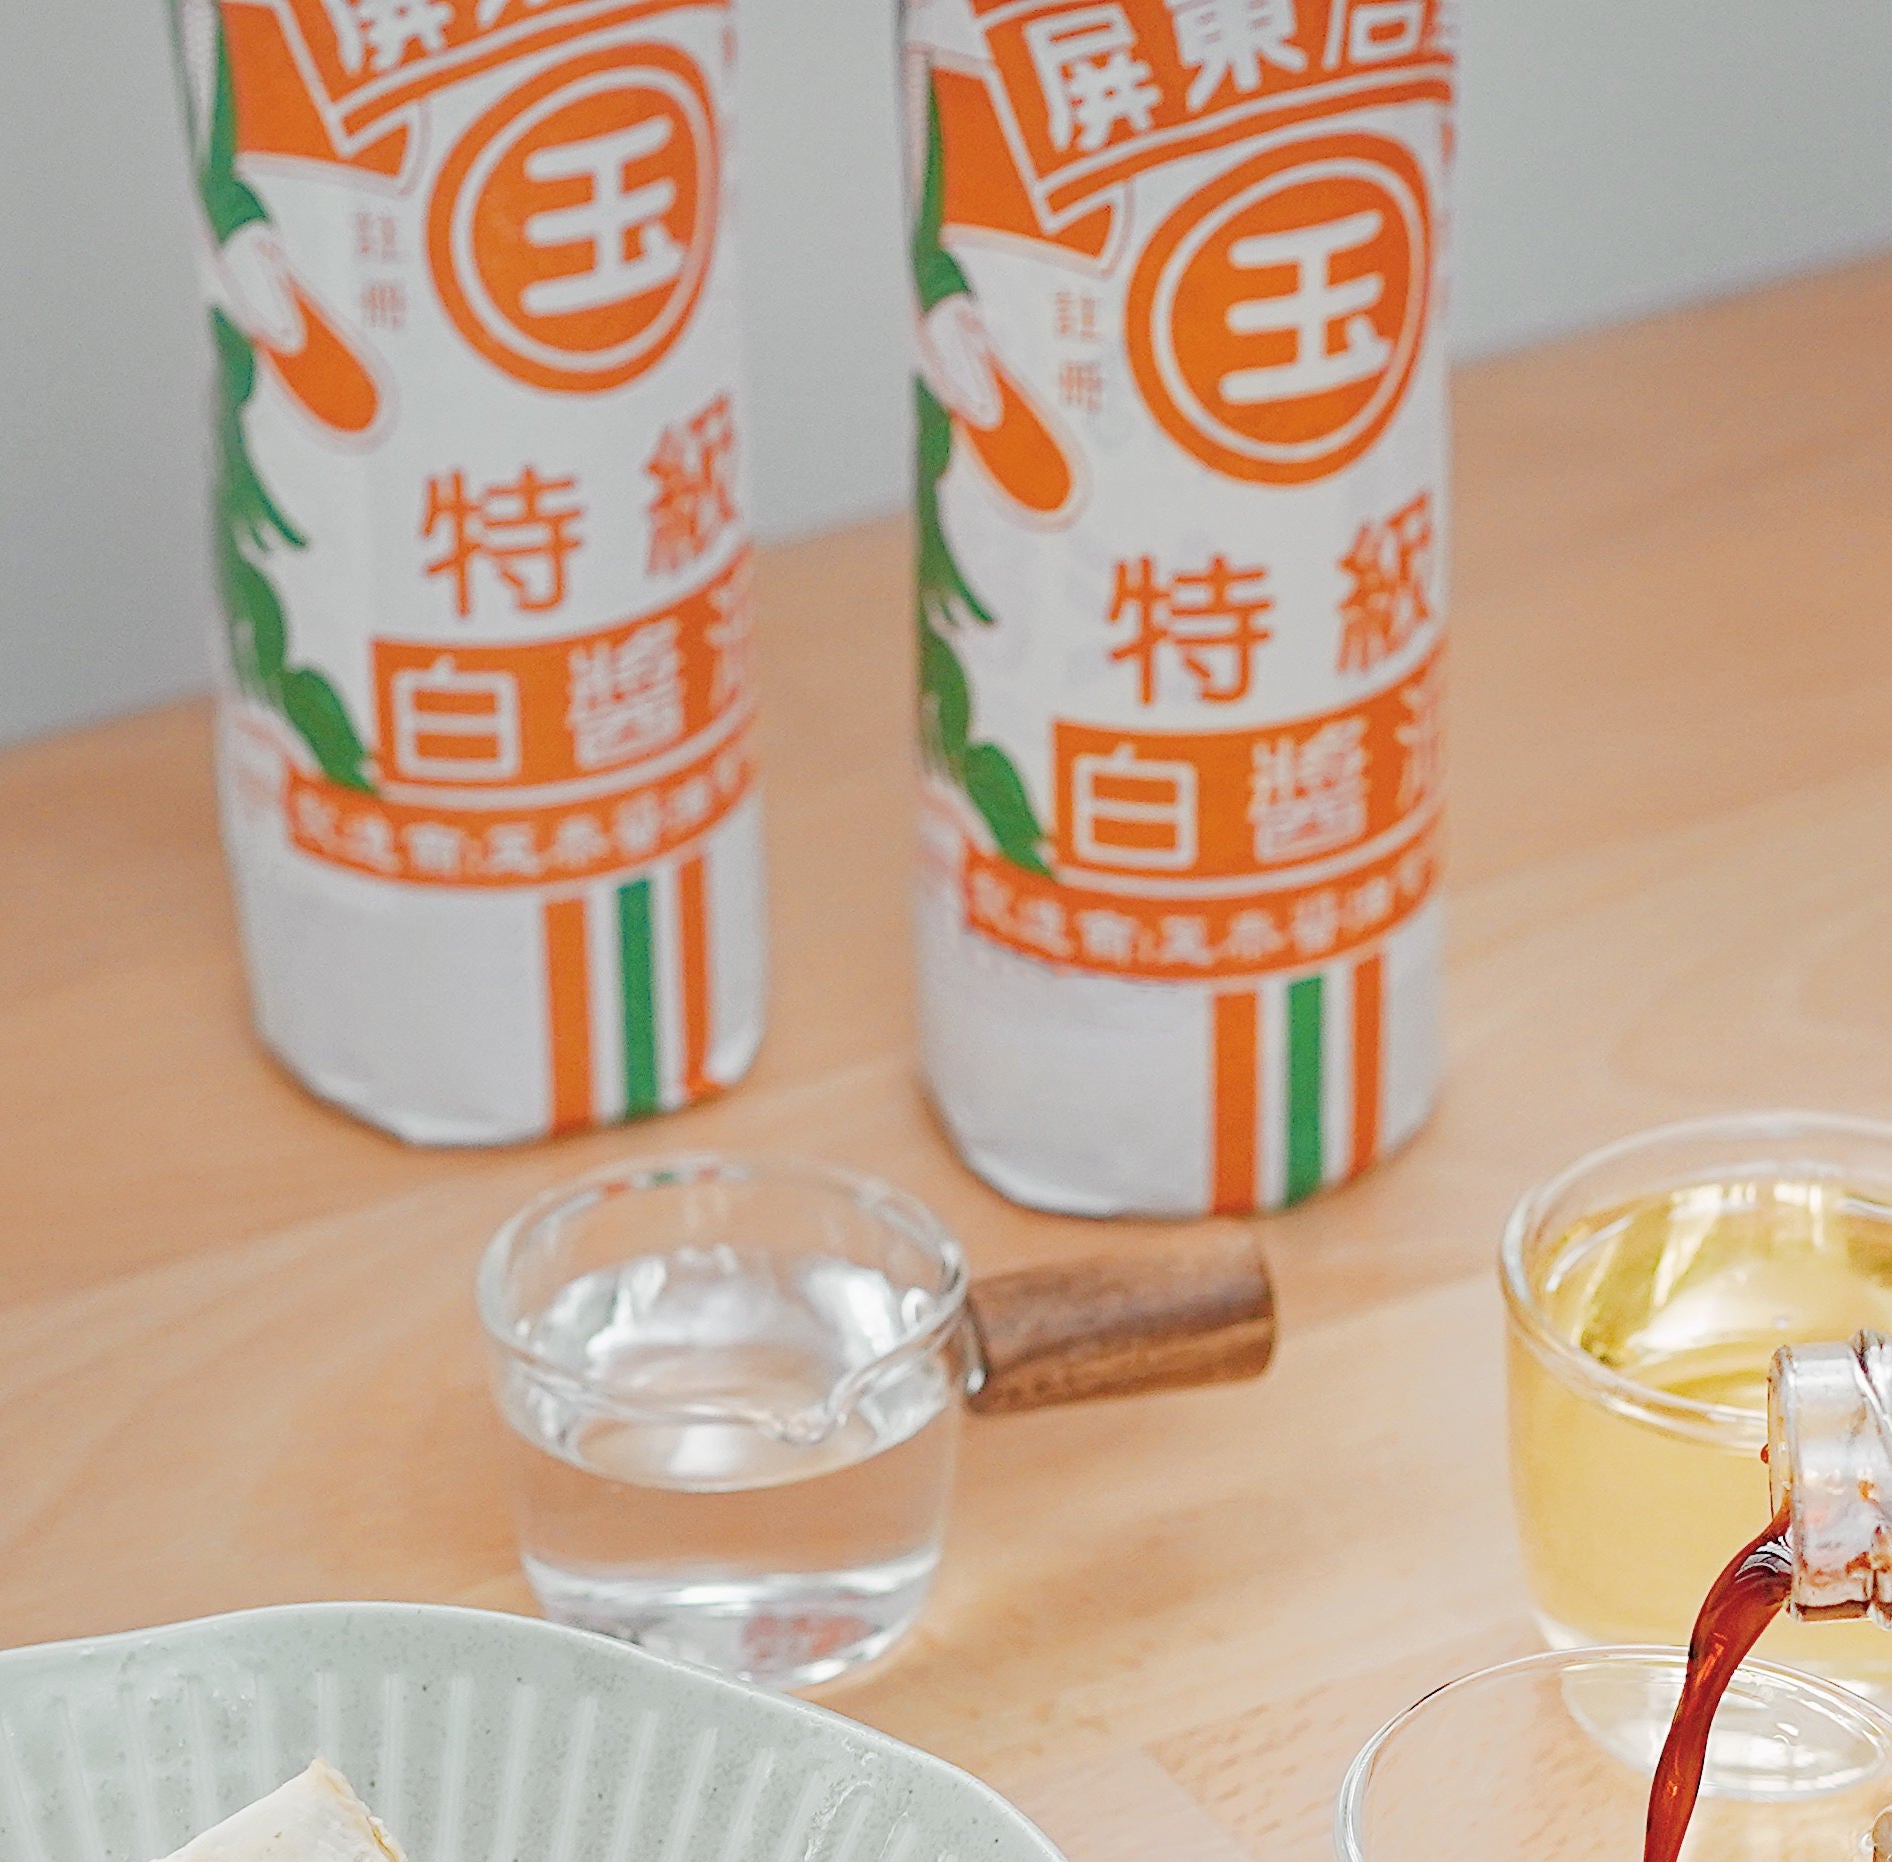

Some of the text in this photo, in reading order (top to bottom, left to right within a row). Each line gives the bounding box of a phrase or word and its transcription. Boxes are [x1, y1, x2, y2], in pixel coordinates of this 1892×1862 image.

[521, 113, 688, 317] 玉
[1219, 209, 1396, 405] 玉
[391, 592, 742, 782] 白醬
